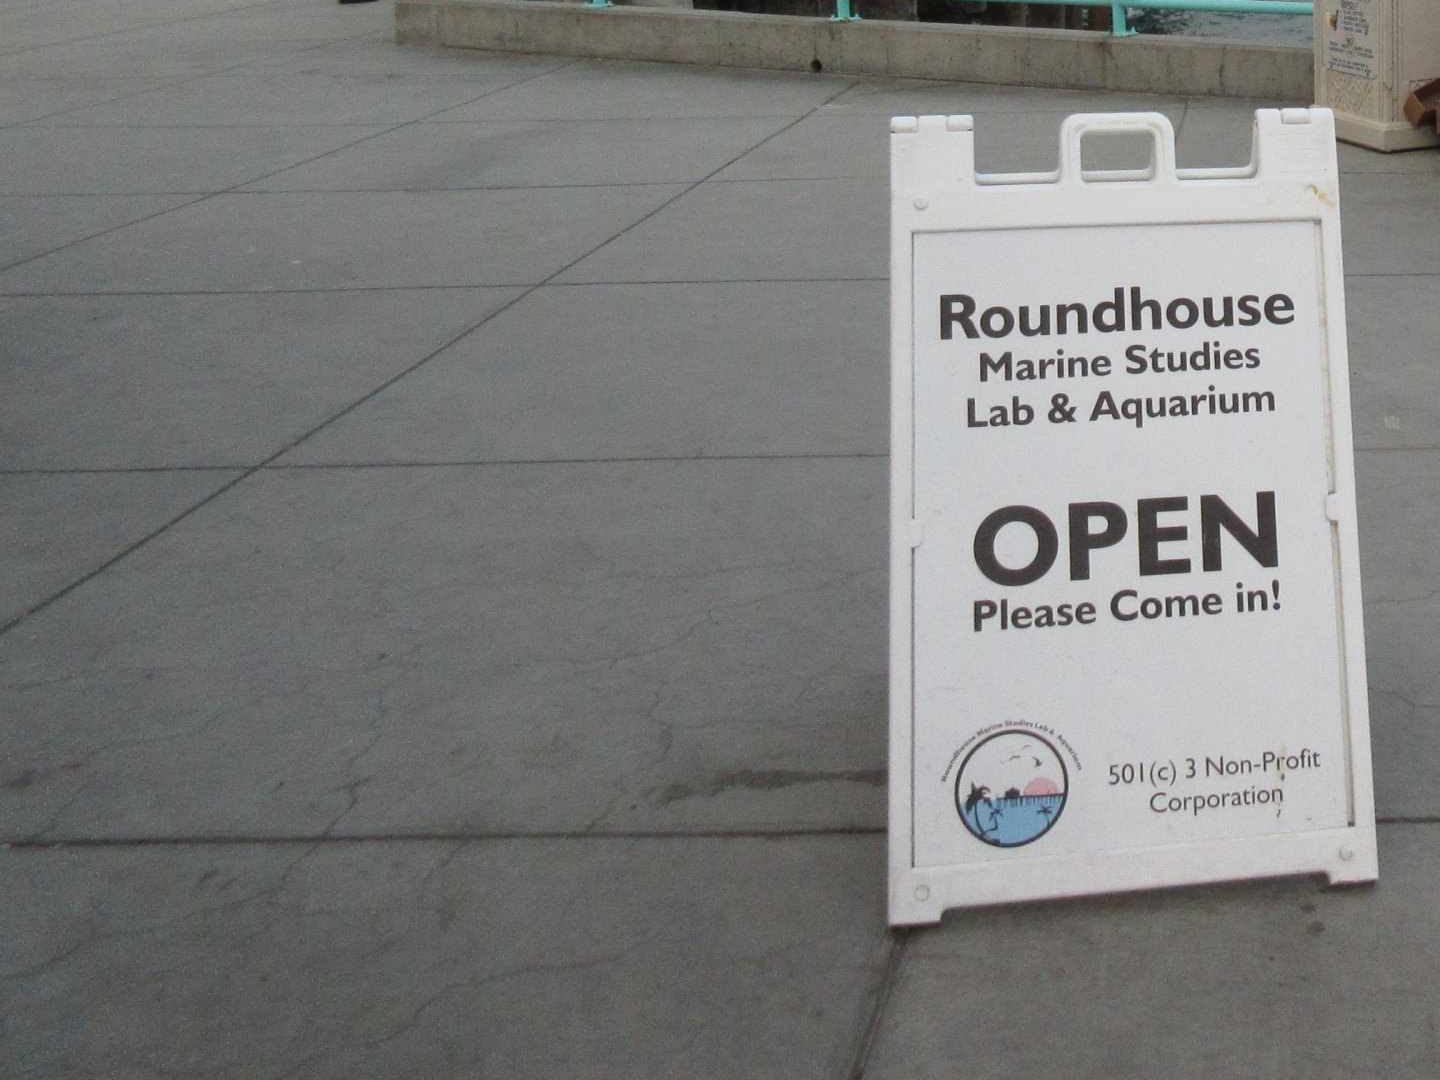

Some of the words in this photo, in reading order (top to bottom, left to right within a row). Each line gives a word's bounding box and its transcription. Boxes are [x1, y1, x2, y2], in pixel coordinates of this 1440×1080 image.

[939, 286, 1295, 340] Roundhouse
[979, 349, 1112, 382] Marine
[1125, 341, 1261, 375] Studies
[966, 396, 1034, 428] Lab
[1047, 392, 1078, 423] &
[1089, 385, 1275, 428] Aquarium
[973, 491, 1279, 587] OPEN
[973, 598, 1097, 633] Please
[1110, 589, 1223, 621] Come
[1236, 580, 1282, 613] in!
[941, 736, 976, 783] Roundhouse
[976, 722, 1004, 737] Marine
[1004, 719, 1034, 728] Studies
[1034, 720, 1049, 732] Lab
[1056, 733, 1083, 772] Aquarium
[1108, 759, 1177, 788] 501(c)
[1185, 758, 1196, 779] 3
[1205, 748, 1321, 778] Non-Profit
[1149, 786, 1284, 816] Corporation
